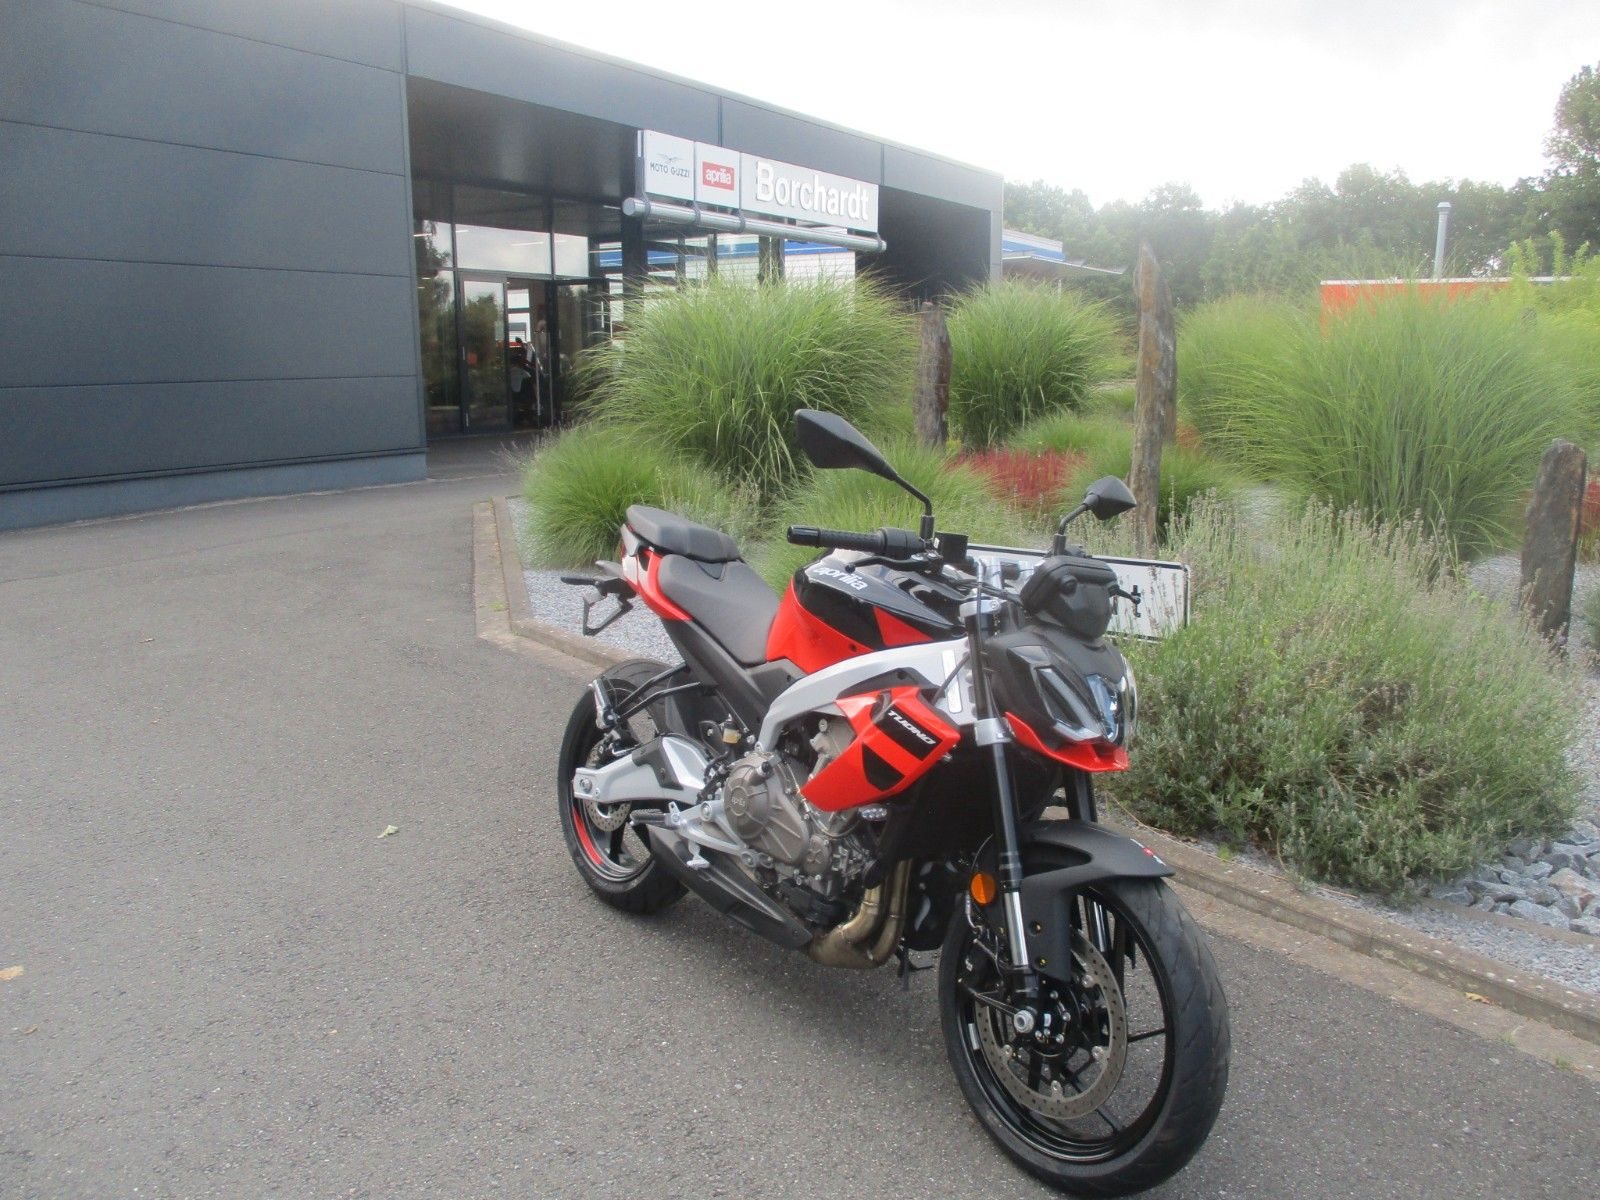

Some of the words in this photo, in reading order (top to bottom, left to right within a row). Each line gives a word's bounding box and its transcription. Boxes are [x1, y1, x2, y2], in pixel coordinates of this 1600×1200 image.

[650, 162, 669, 174] MOTO
[670, 166, 690, 178] GUZZI
[705, 168, 731, 184] aprilia
[756, 160, 869, 220] Borchardt
[813, 567, 868, 590] aprilia
[887, 710, 937, 745] TUONO
